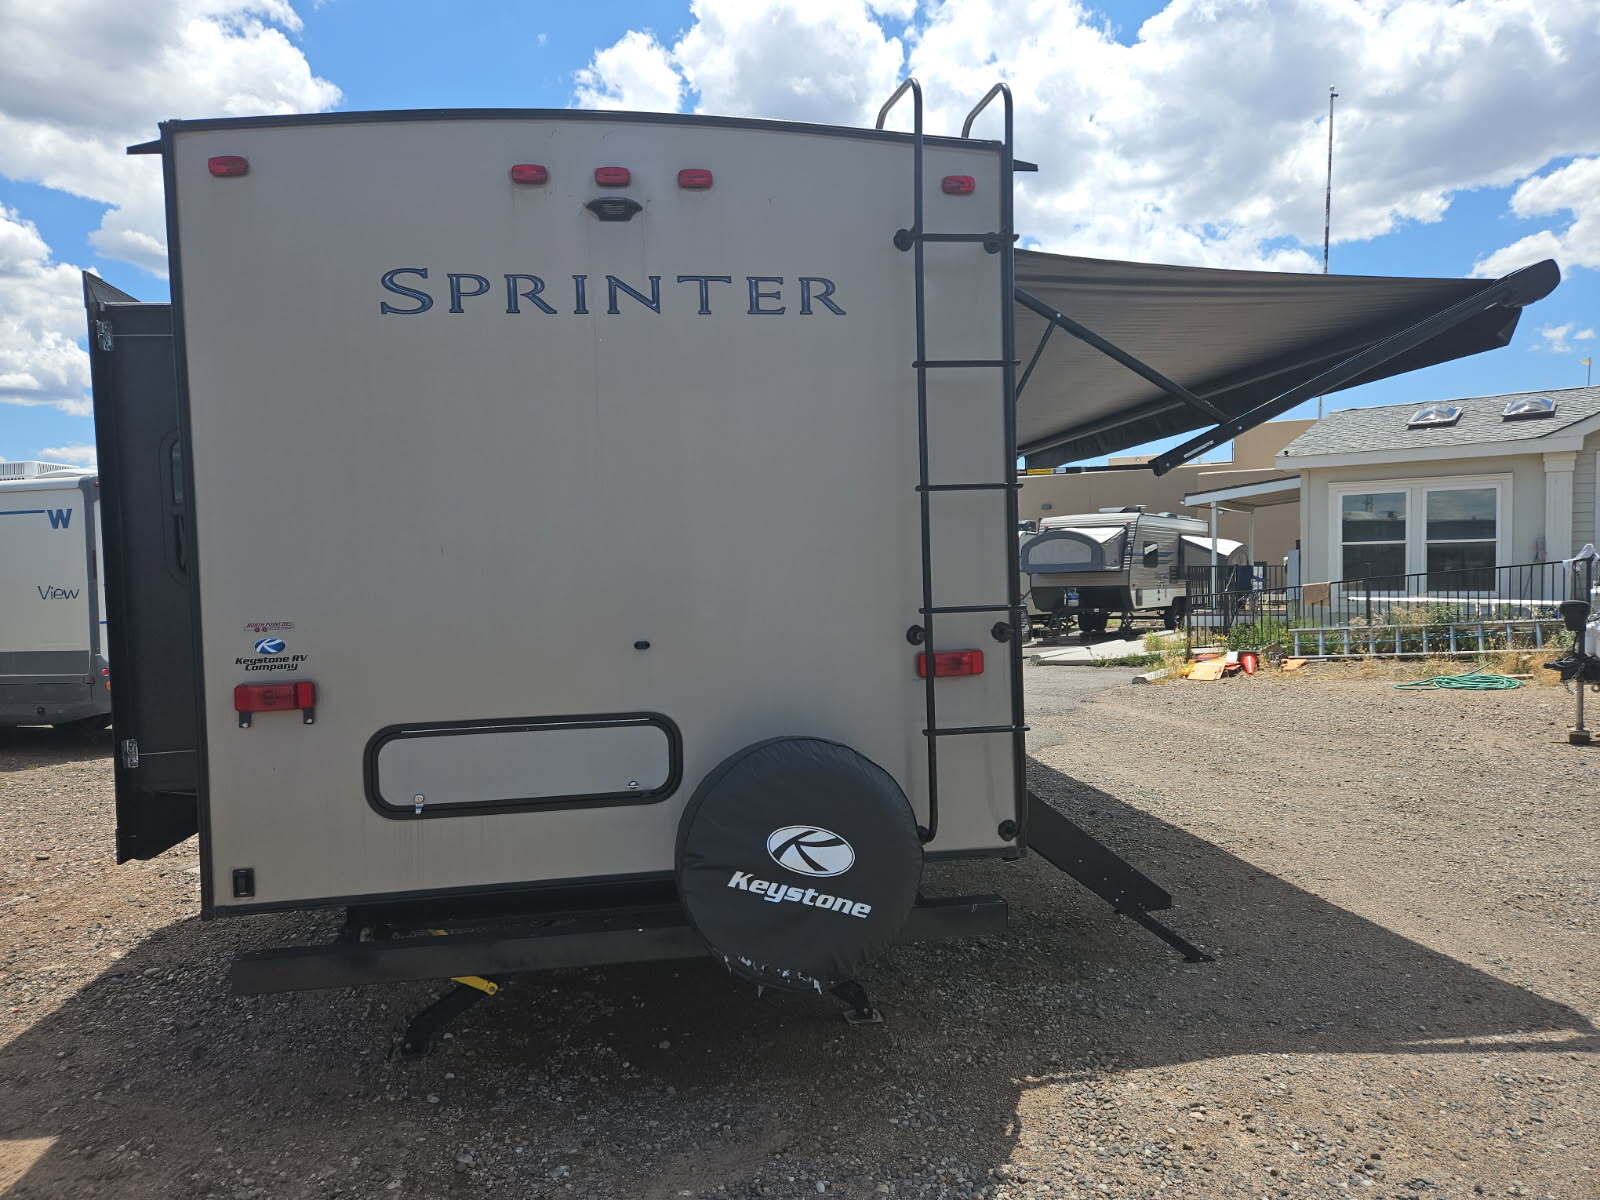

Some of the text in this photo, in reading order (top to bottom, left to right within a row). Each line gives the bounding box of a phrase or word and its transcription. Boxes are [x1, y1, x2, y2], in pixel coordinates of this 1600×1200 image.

[380, 267, 847, 315] SPRINTER
[47, 508, 72, 529] W
[37, 585, 80, 600] View
[235, 654, 308, 665] Keystone RV
[245, 662, 299, 671] Company
[727, 871, 872, 919] Keystone
